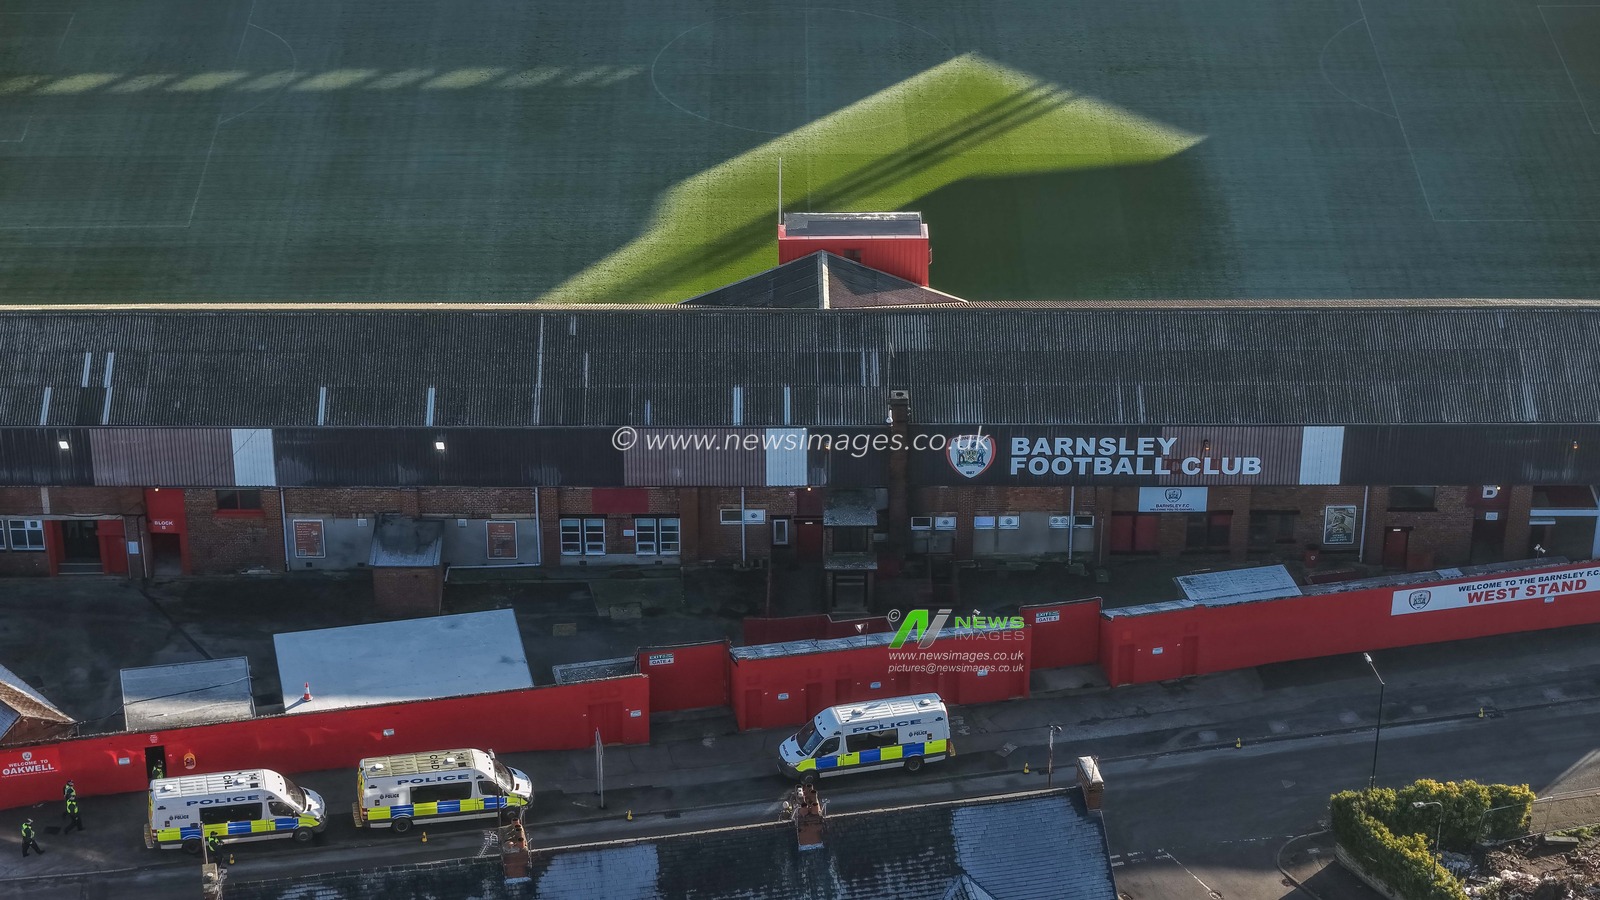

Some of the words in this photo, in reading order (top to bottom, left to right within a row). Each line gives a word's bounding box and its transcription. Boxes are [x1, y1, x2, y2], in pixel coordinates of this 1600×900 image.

[1011, 437, 1177, 455] BARNSLEY
[1010, 457, 1171, 475] FOOTBALL
[1181, 457, 1262, 475] CLUB
[1458, 581, 1502, 592] WELCOME
[1504, 579, 1516, 587] TO
[1519, 577, 1536, 586] THE
[1537, 571, 1584, 583] BARNSLEY
[1467, 586, 1520, 603] WEST
[1525, 578, 1587, 597] STAND
[852, 718, 922, 733] POLICE
[2, 763, 54, 776] OAKWELL
[8, 760, 37, 768] WELCOME
[430, 754, 440, 770] CHD
[223, 774, 232, 790] CHL
[397, 773, 470, 785] POLICE
[186, 794, 260, 806] POLICE
